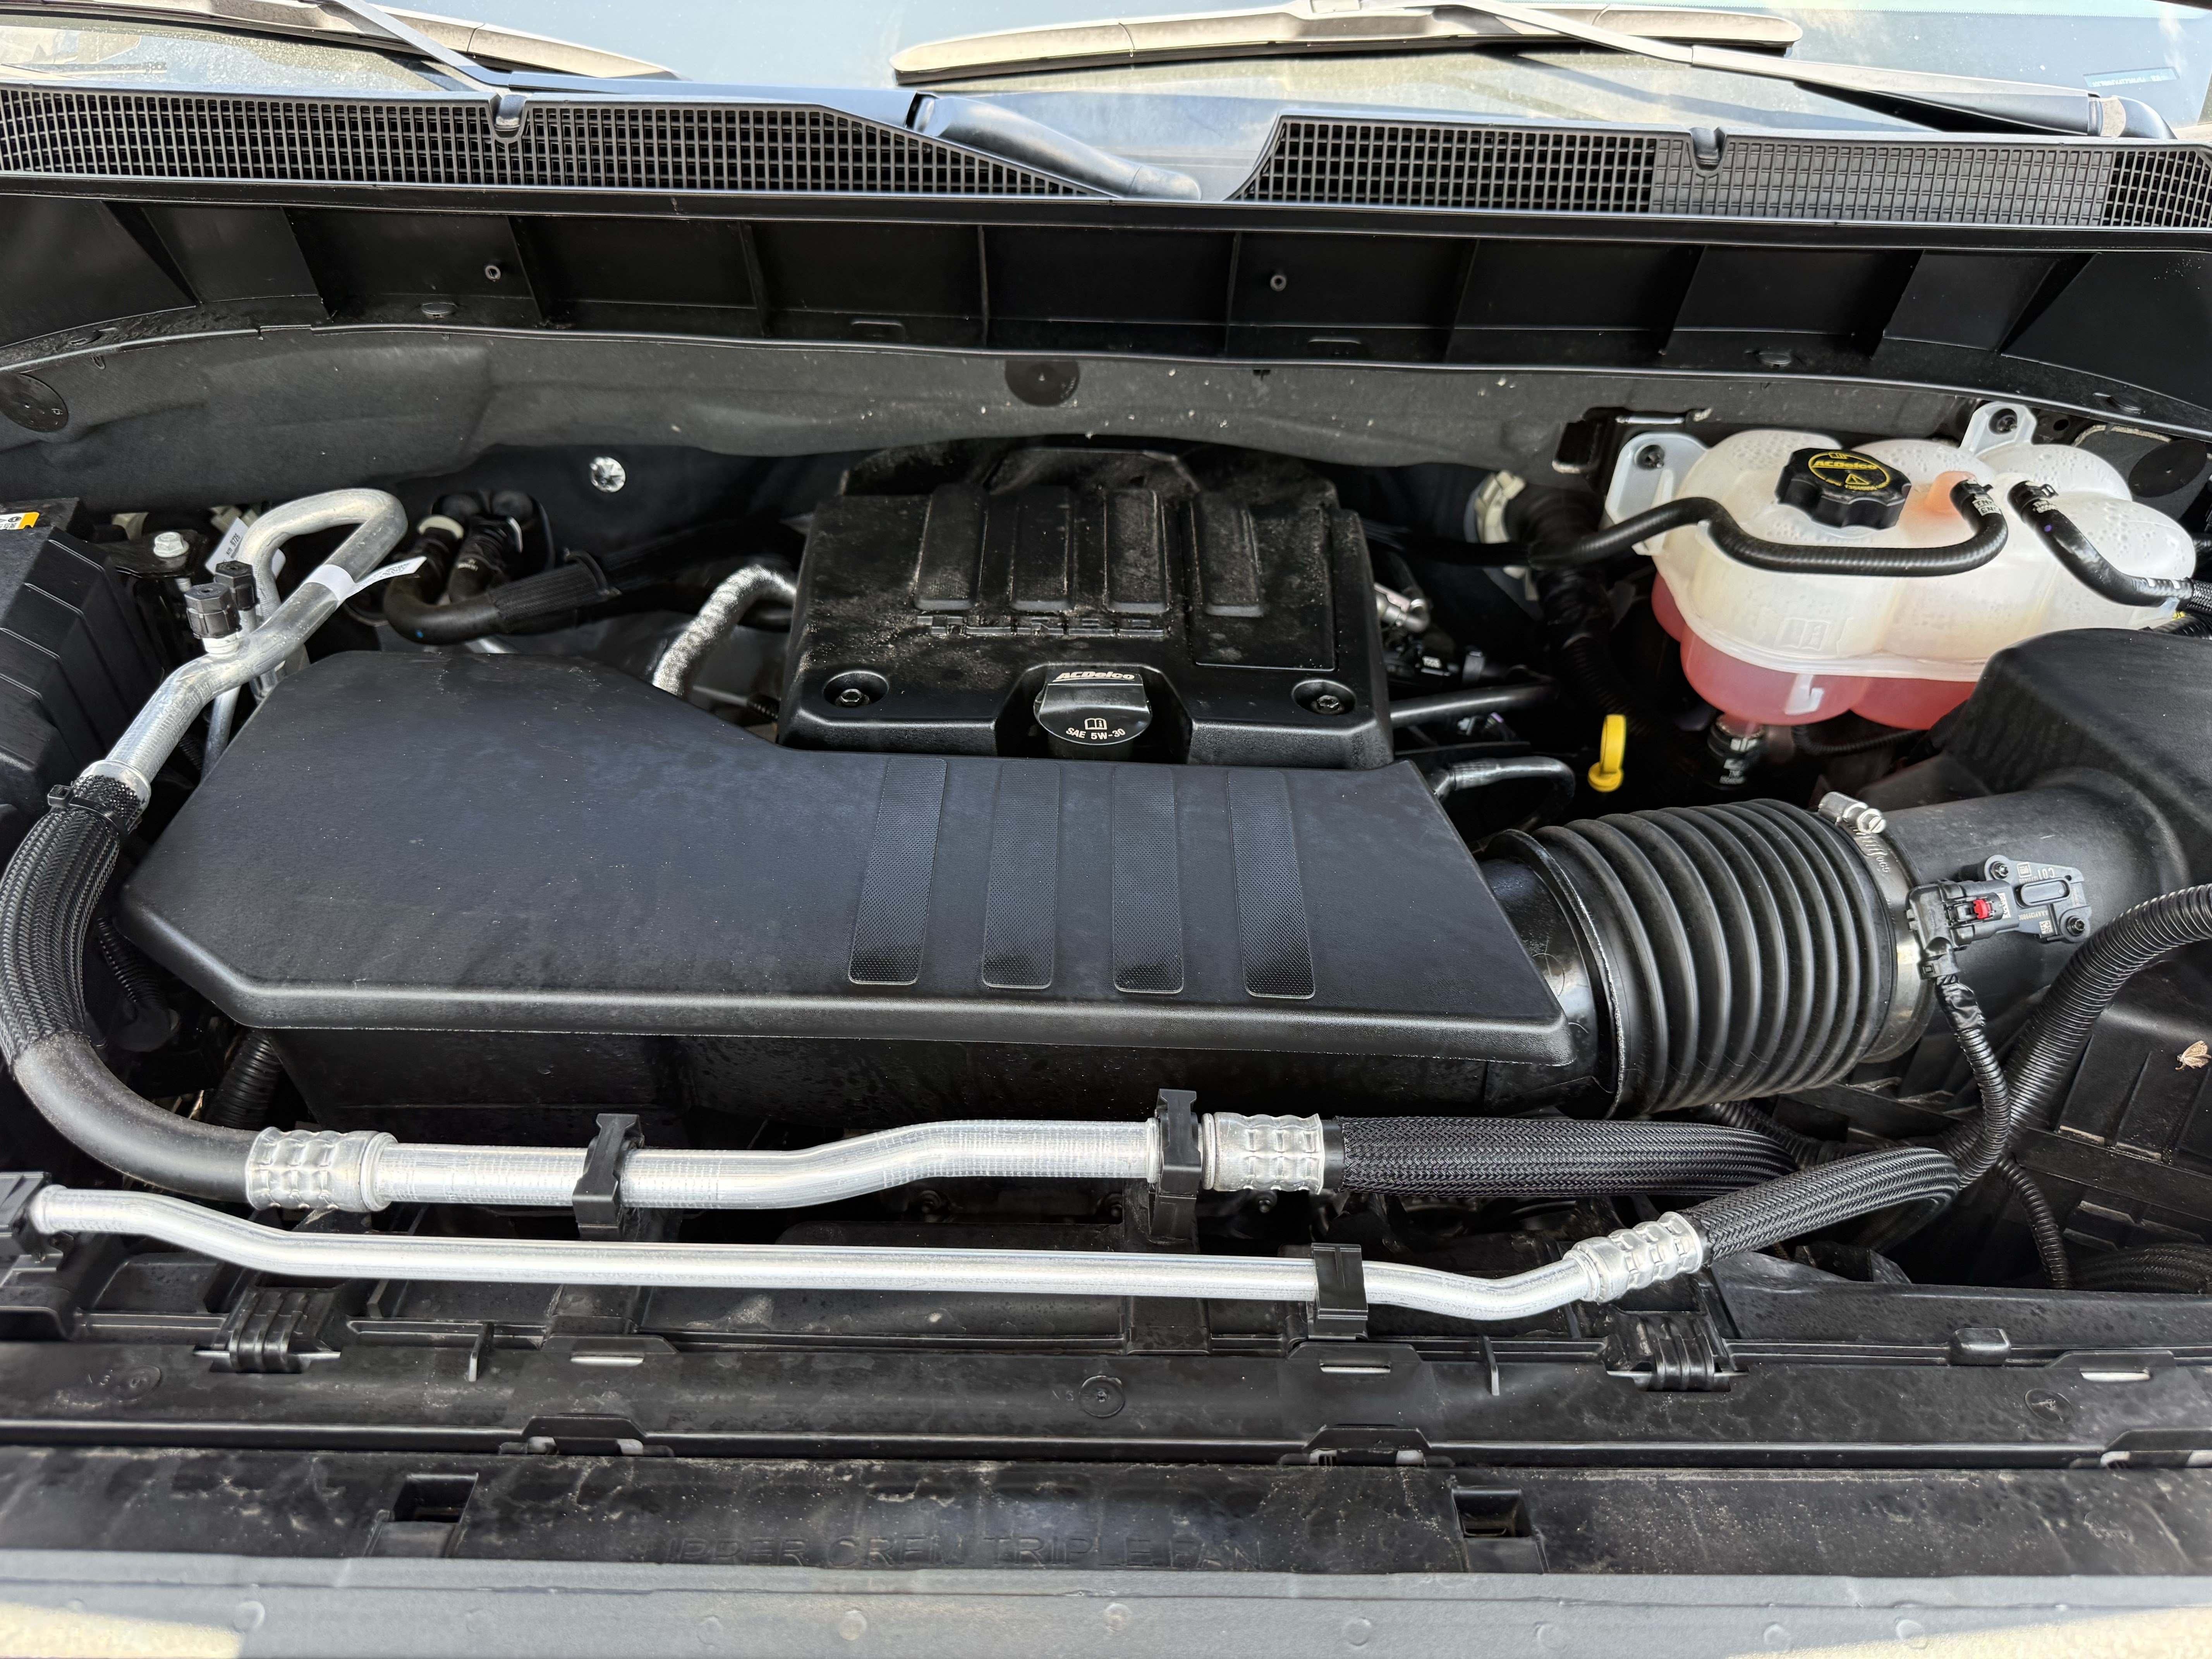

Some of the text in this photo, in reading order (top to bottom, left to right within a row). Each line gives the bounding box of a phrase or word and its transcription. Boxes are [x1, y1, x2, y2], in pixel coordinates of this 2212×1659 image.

[1813, 460, 1878, 469] ACDelco
[1056, 671, 1135, 680] ACDelco
[1066, 727, 1126, 740] SAE 5W-30
[983, 1536, 1152, 1567] TRIPLE
[1168, 1539, 1263, 1570] FAN
